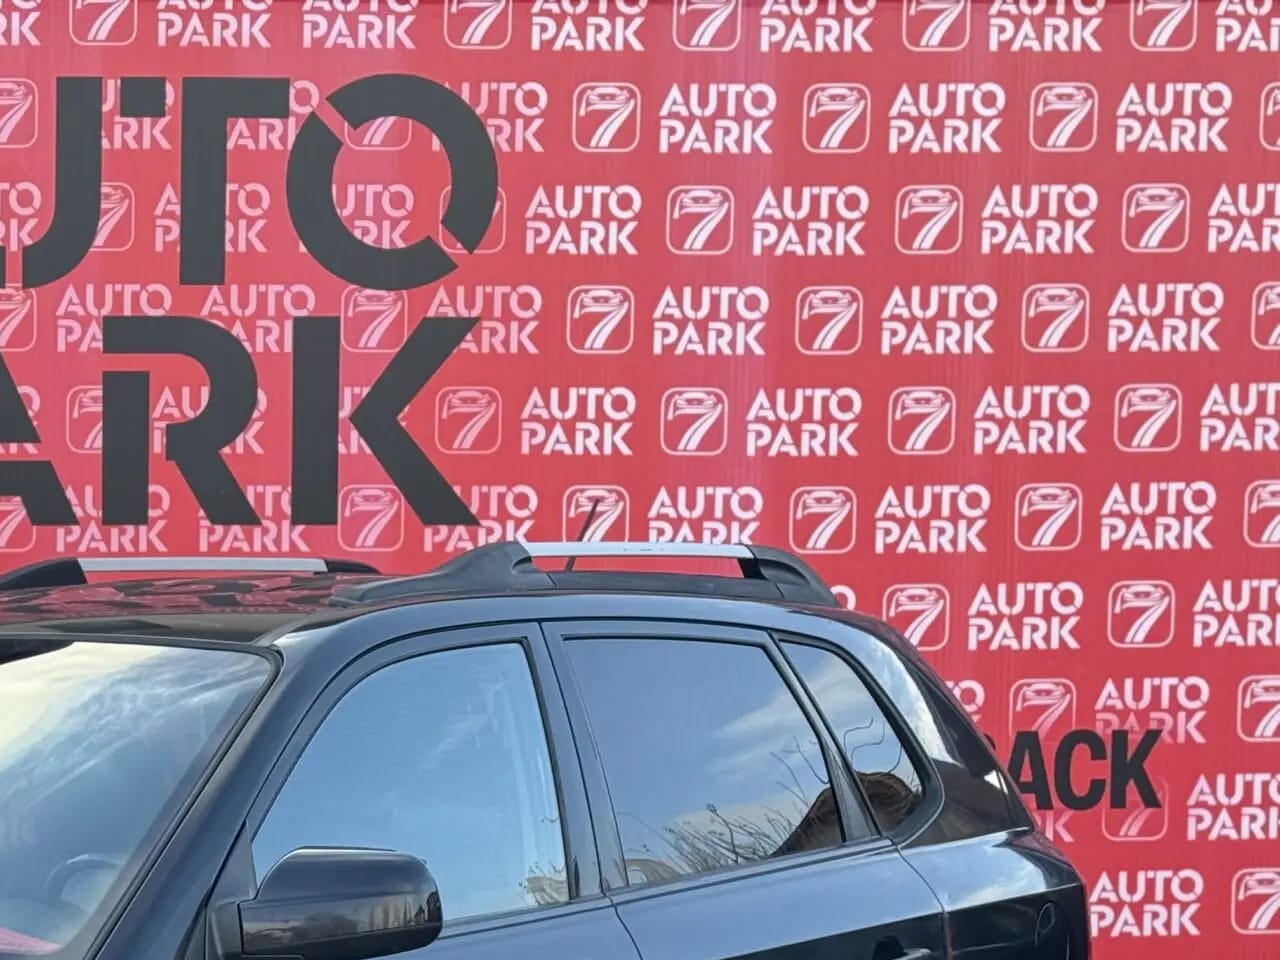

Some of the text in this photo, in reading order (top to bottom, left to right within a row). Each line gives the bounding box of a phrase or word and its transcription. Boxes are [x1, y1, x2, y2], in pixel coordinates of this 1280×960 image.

[158, 12, 271, 48] PARK
[303, 14, 416, 49] PARK
[531, 16, 645, 51] PARK
[760, 17, 873, 53] PARK
[989, 17, 1102, 52] PARK
[659, 83, 777, 118] AUTO
[888, 82, 1006, 117] AUTO
[1116, 82, 1232, 116] AUTO
[659, 118, 773, 154] PARK
[889, 118, 1002, 153] PARK
[1116, 117, 1229, 152] PARK
[525, 185, 641, 219] AUTO
[752, 185, 869, 220] AUTO
[981, 184, 1098, 218] AUTO
[526, 221, 638, 255] PARK
[753, 221, 865, 256] PARK
[981, 219, 1094, 254] PARK
[56, 284, 171, 316] AUTO
[200, 284, 315, 316] AUTO
[427, 285, 542, 318] AUTO
[653, 286, 769, 320] AUTO
[881, 284, 997, 319] AUTO
[1108, 282, 1224, 317] AUTO
[653, 321, 766, 355] PARK
[881, 320, 993, 355] PARK
[1108, 317, 1220, 352] PARK
[521, 387, 636, 420] AUTO
[746, 387, 862, 421] AUTO
[974, 384, 1090, 419] AUTO
[1200, 383, 1280, 416] AUT
[522, 422, 632, 455] PARK
[747, 422, 858, 456] PARK
[974, 420, 1086, 454] PARK
[1200, 417, 1280, 451] PAR
[648, 486, 763, 520] AUTO
[875, 484, 990, 518] AUTO
[1101, 481, 1216, 515] AUTO
[57, 520, 167, 552] PARK
[200, 520, 309, 552] PARK
[875, 519, 987, 553] PARK
[1101, 516, 1212, 550] PARK
[968, 582, 1083, 616] AUTO
[1193, 579, 1280, 612] AUT
[968, 616, 1080, 650] PARK
[1193, 613, 1280, 647] PAR
[1095, 676, 1209, 709] AUTO
[990, 728, 1163, 811] ACK
[1188, 773, 1280, 805] AUT
[1188, 807, 1280, 840] PAR
[1089, 869, 1203, 903] AUTO
[1090, 903, 1200, 937] PARK
